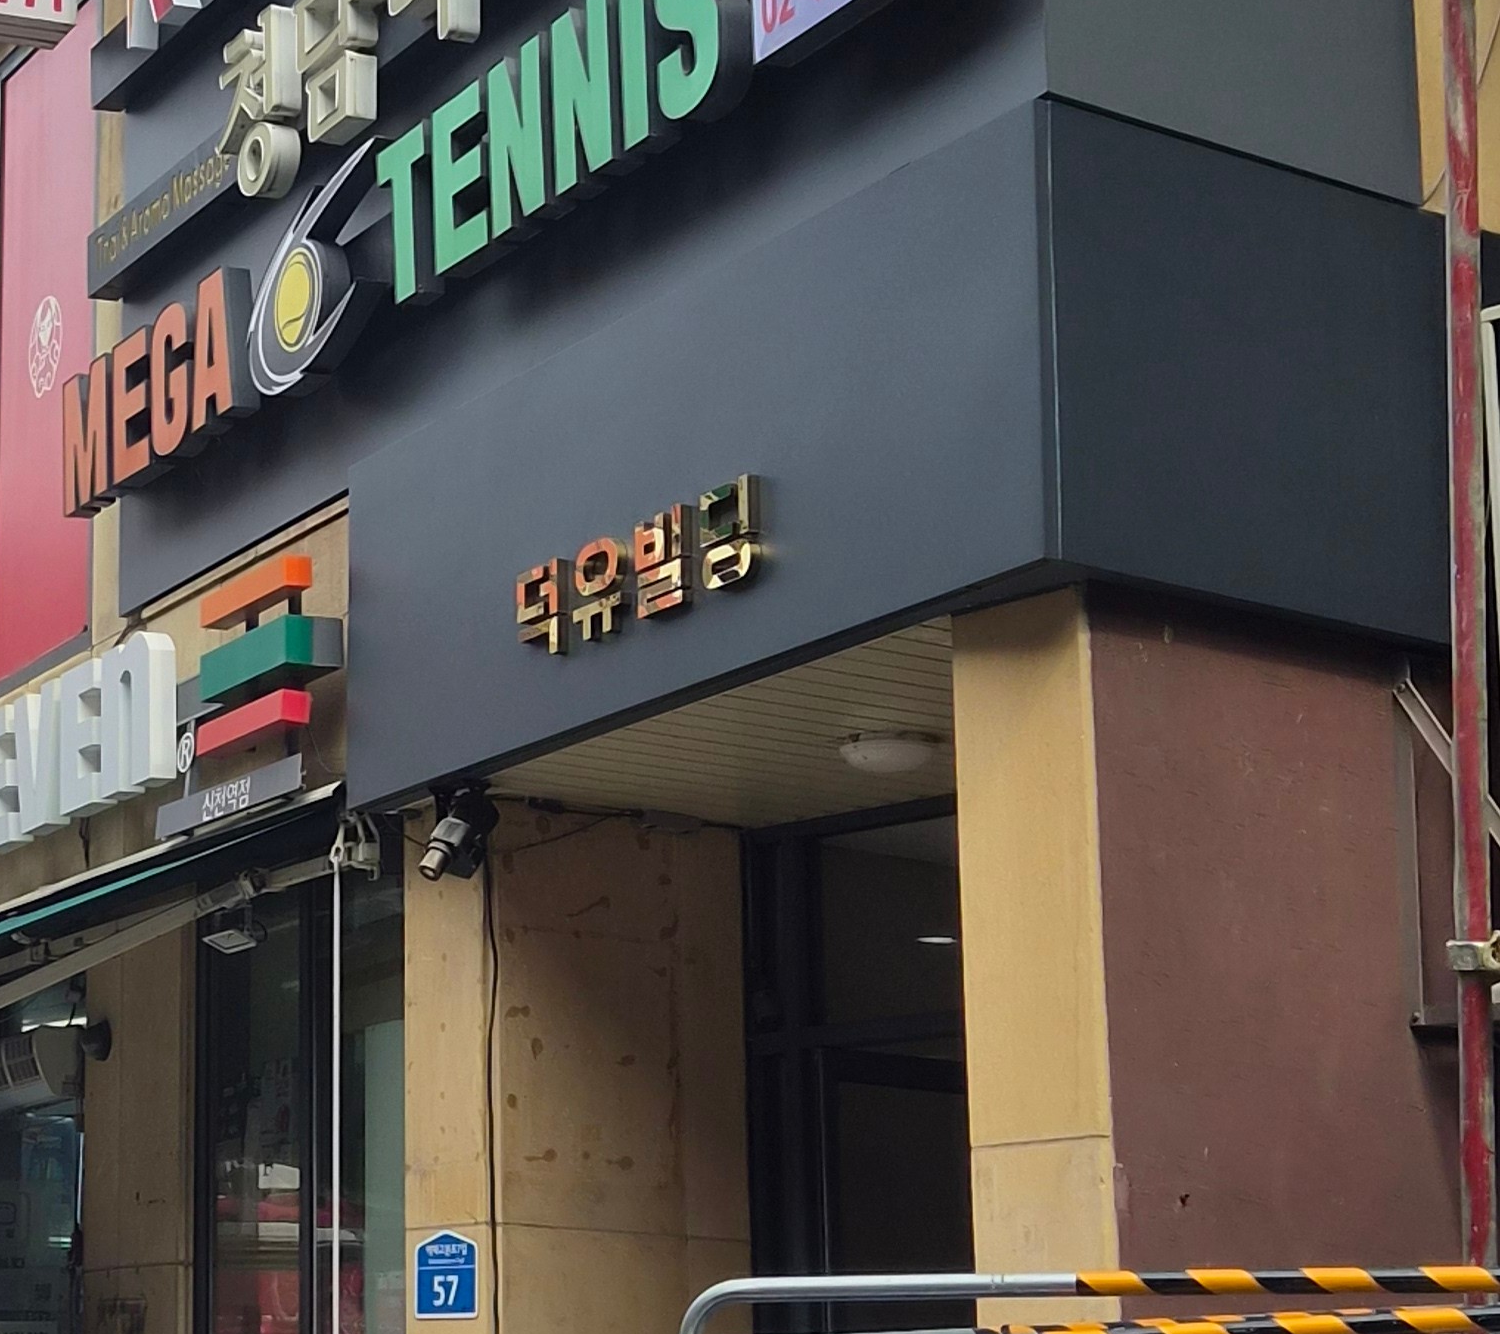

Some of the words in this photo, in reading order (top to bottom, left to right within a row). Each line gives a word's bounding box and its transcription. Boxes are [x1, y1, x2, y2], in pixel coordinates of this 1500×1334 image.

[62, 265, 242, 519] MEGA
[515, 472, 763, 657] 덕유빌딩
[200, 777, 252, 824] 신천역점
[432, 1274, 459, 1307] 57
